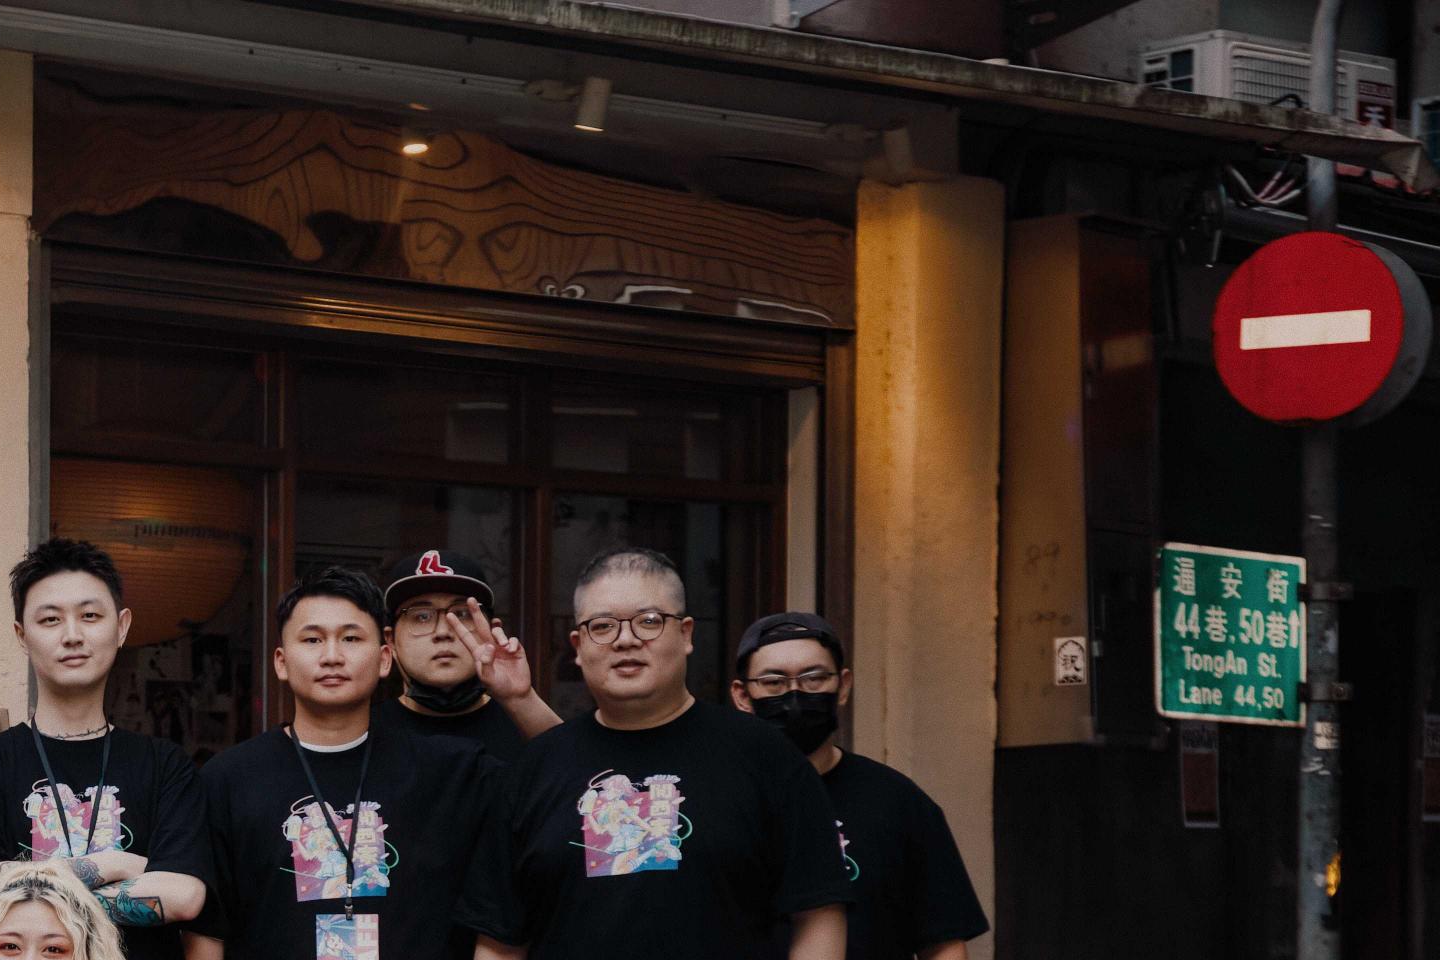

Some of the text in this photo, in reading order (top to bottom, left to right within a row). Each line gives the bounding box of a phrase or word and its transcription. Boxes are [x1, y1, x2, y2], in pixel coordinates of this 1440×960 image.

[1172, 556, 1289, 604] 通安街
[1181, 645, 1282, 679] TongAn St.
[1178, 678, 1285, 711] Lane 44,50
